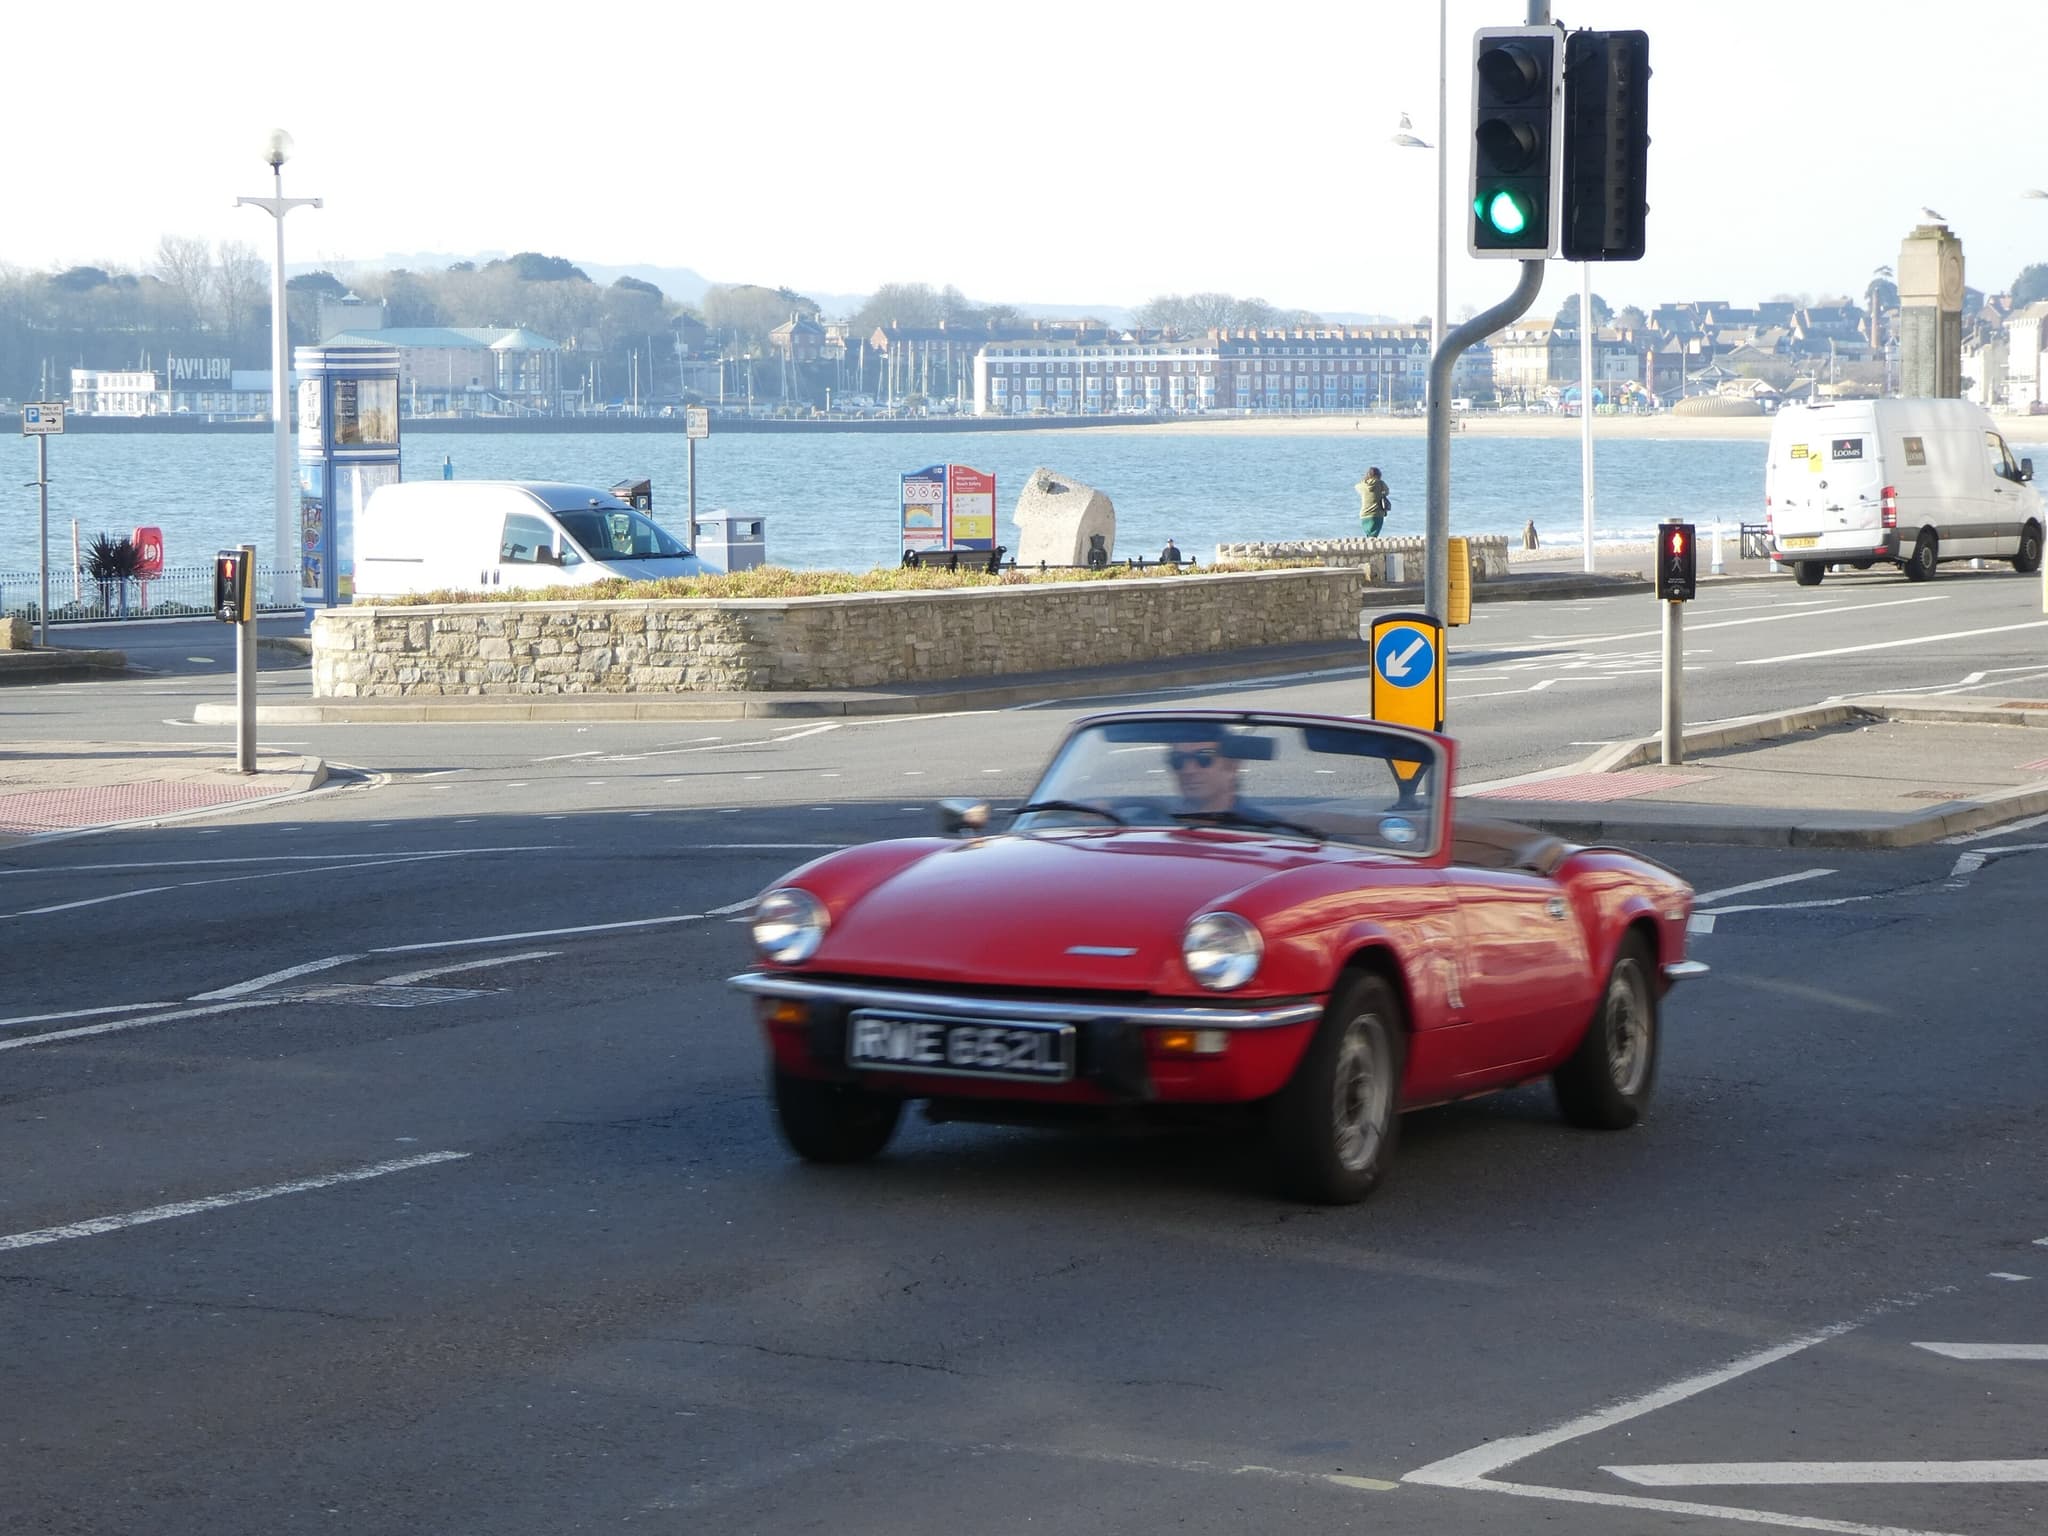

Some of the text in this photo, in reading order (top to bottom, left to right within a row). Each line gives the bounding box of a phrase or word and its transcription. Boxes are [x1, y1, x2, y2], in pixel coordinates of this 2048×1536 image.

[167, 358, 231, 380] PAVILION
[28, 409, 38, 422] P
[1833, 448, 1861, 458] LOOMIS
[640, 498, 647, 509] P
